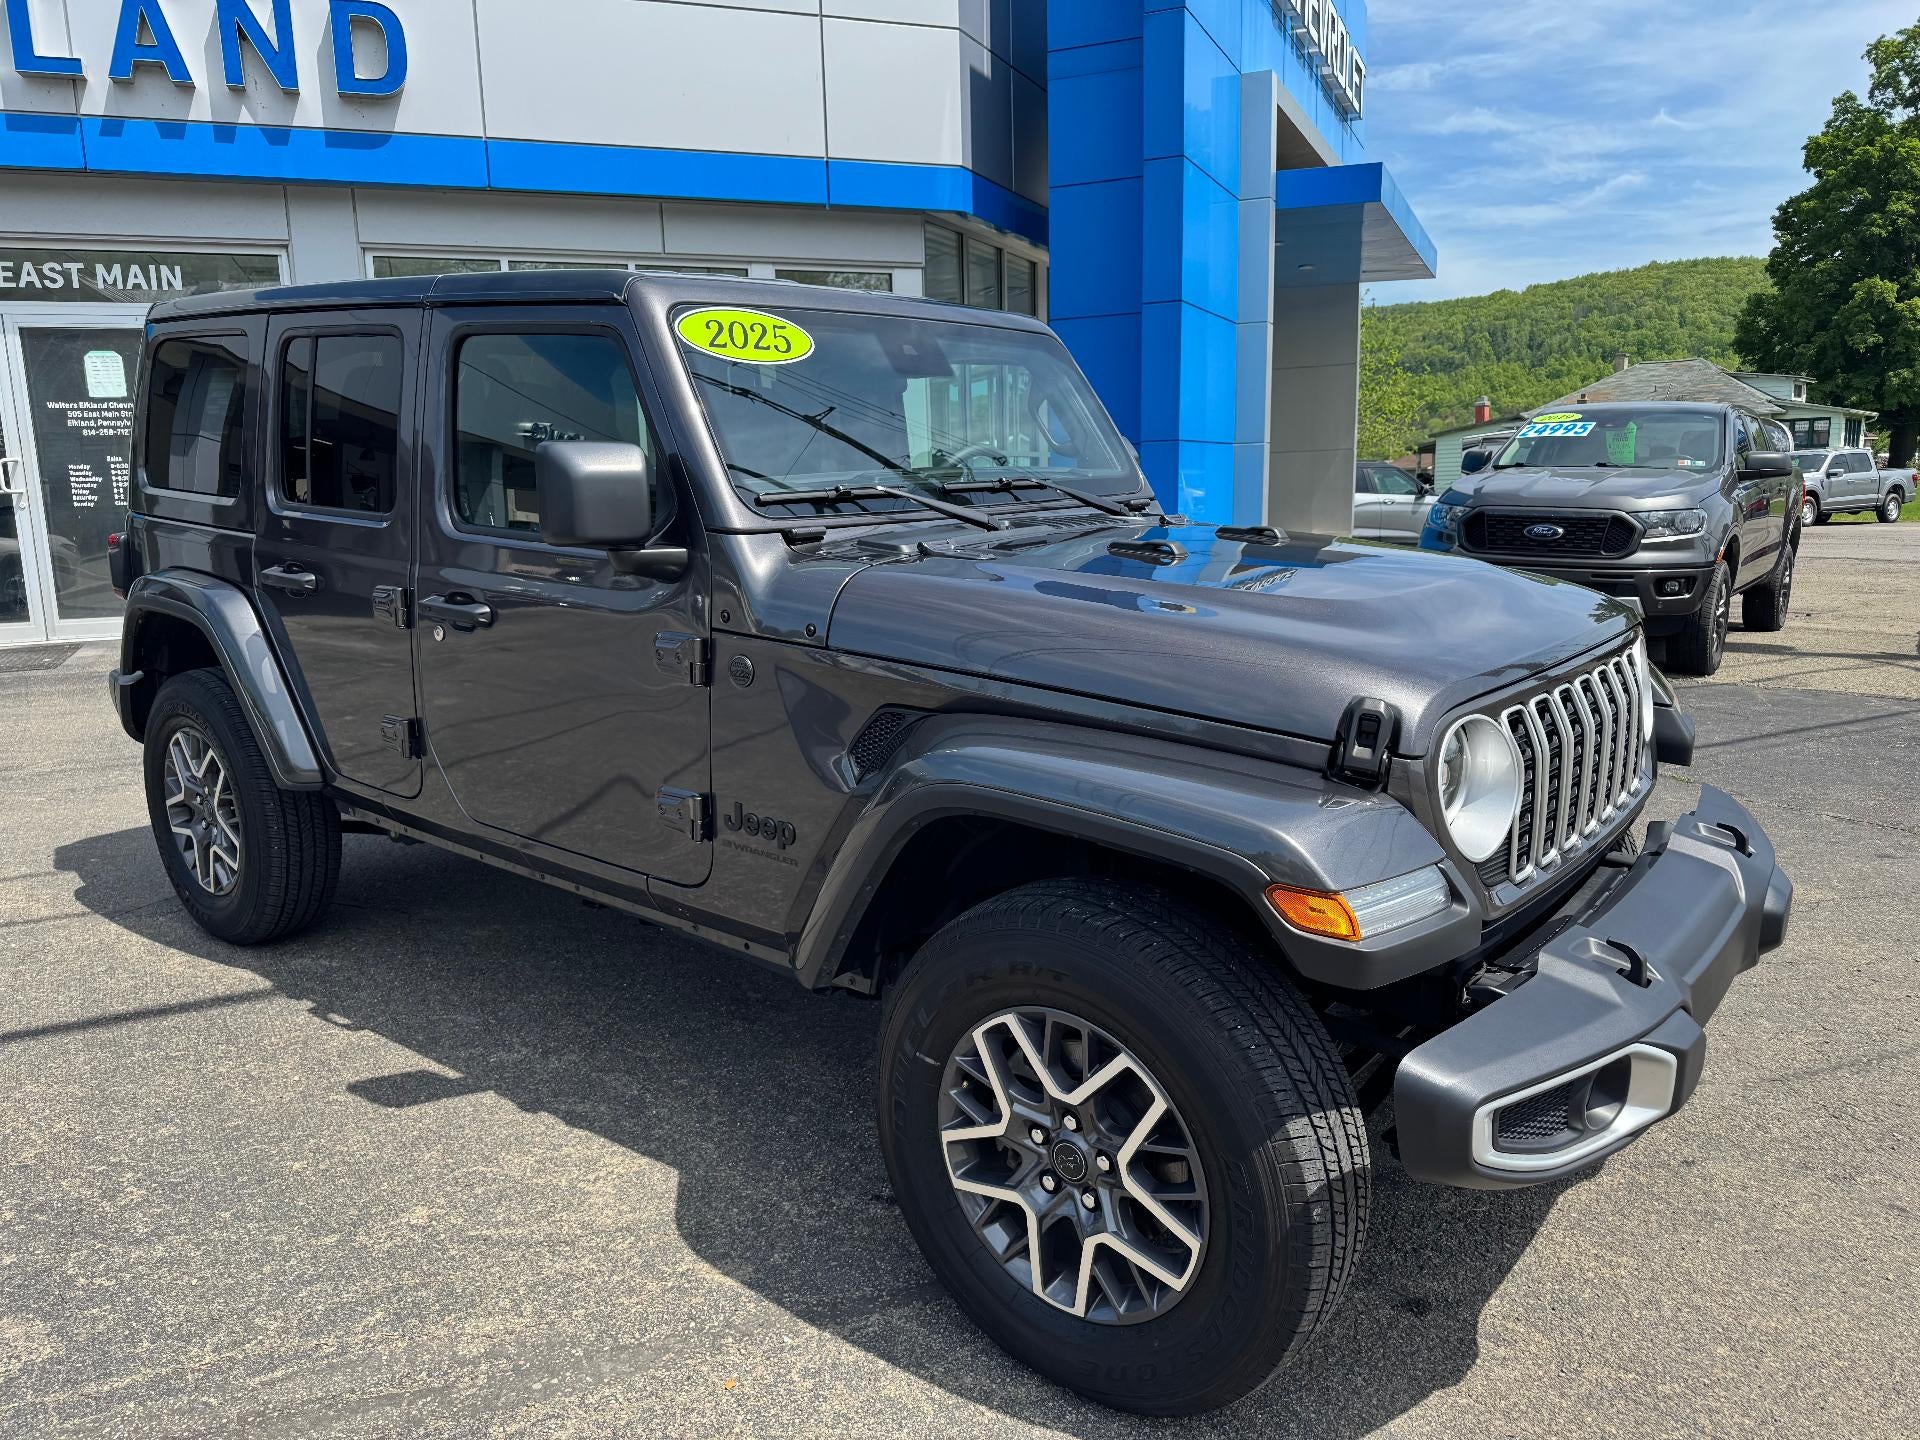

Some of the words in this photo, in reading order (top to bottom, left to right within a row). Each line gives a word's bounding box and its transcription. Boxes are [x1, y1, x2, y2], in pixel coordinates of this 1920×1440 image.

[1288, 0, 1366, 119] EVROLET
[0, 261, 84, 289] EAST
[95, 263, 183, 291] MAIN
[704, 319, 792, 354] 2025
[46, 401, 78, 409] Walters
[79, 401, 108, 409] Elkland
[67, 419, 97, 428] Elkland,
[82, 428, 131, 436] 814-258-712
[1519, 423, 1593, 437] 24995
[1531, 526, 1554, 537] Ford
[723, 801, 797, 850] Jeep
[733, 841, 799, 868] WRANGLER
